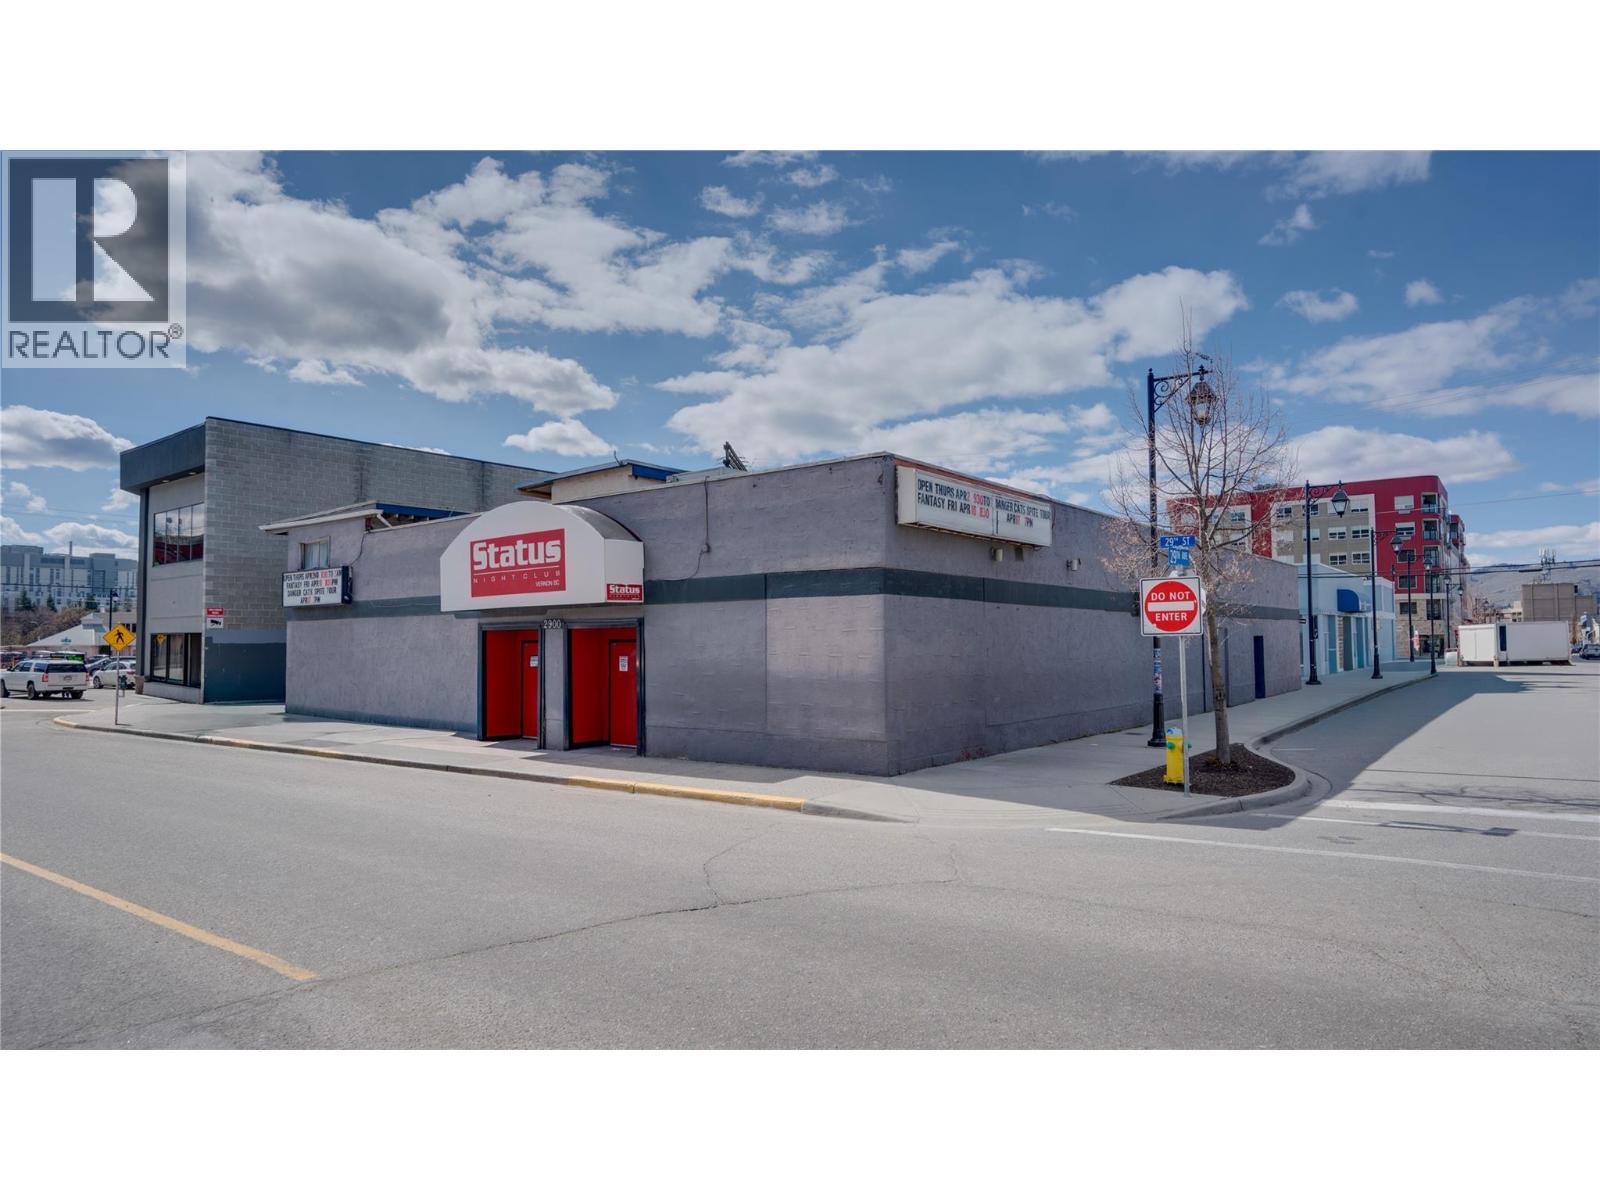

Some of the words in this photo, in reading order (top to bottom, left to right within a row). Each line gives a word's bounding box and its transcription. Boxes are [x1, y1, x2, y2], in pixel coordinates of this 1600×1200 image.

[917, 478, 933, 493] OPEN
[935, 483, 955, 497] THURS
[917, 492, 945, 509] FANTASY
[947, 499, 957, 512] FRI
[1014, 502, 1025, 515] CATS
[1183, 536, 1190, 546] ST
[473, 540, 561, 571] Status
[473, 570, 560, 584] NIGHTCLUB
[609, 584, 640, 593] Status
[1151, 592, 1165, 601] DO
[1169, 591, 1190, 600] NOT
[1155, 612, 1187, 621] ENTER
[543, 619, 561, 629] 2900
